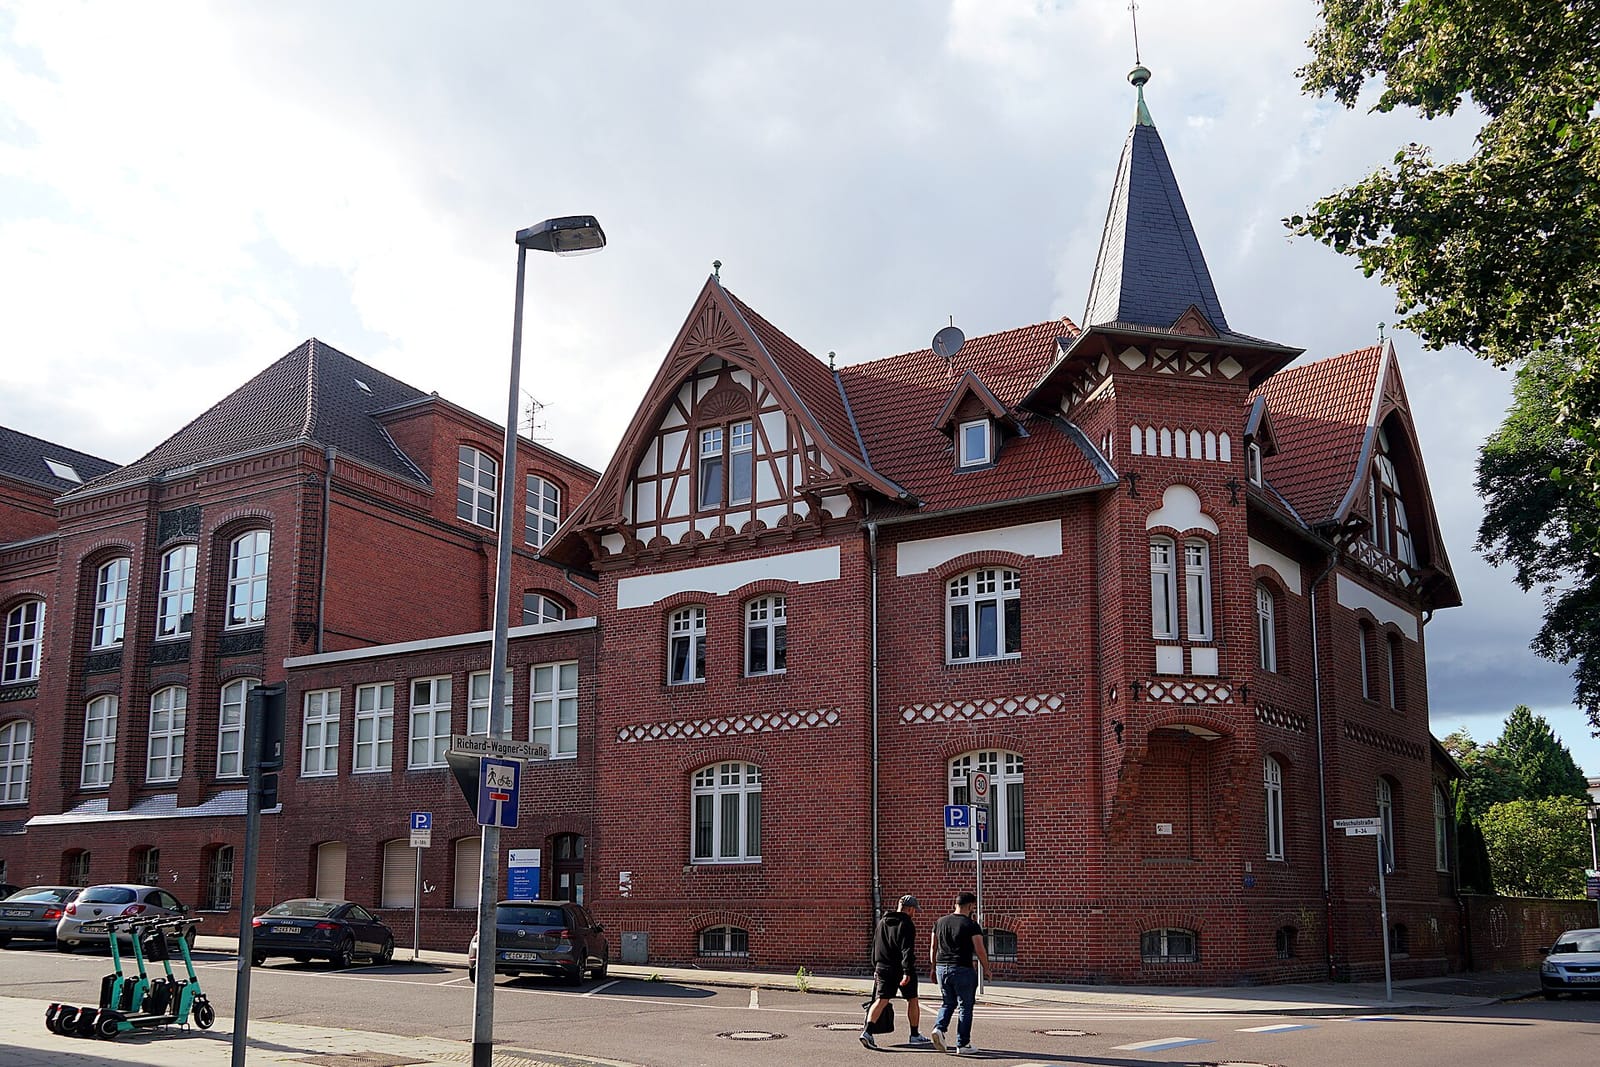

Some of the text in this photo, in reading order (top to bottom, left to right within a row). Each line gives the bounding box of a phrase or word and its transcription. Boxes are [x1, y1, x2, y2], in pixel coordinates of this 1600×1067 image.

[457, 738, 547, 756] Richard-Wagner-Straße
[415, 814, 427, 828] P
[950, 808, 963, 825] P
